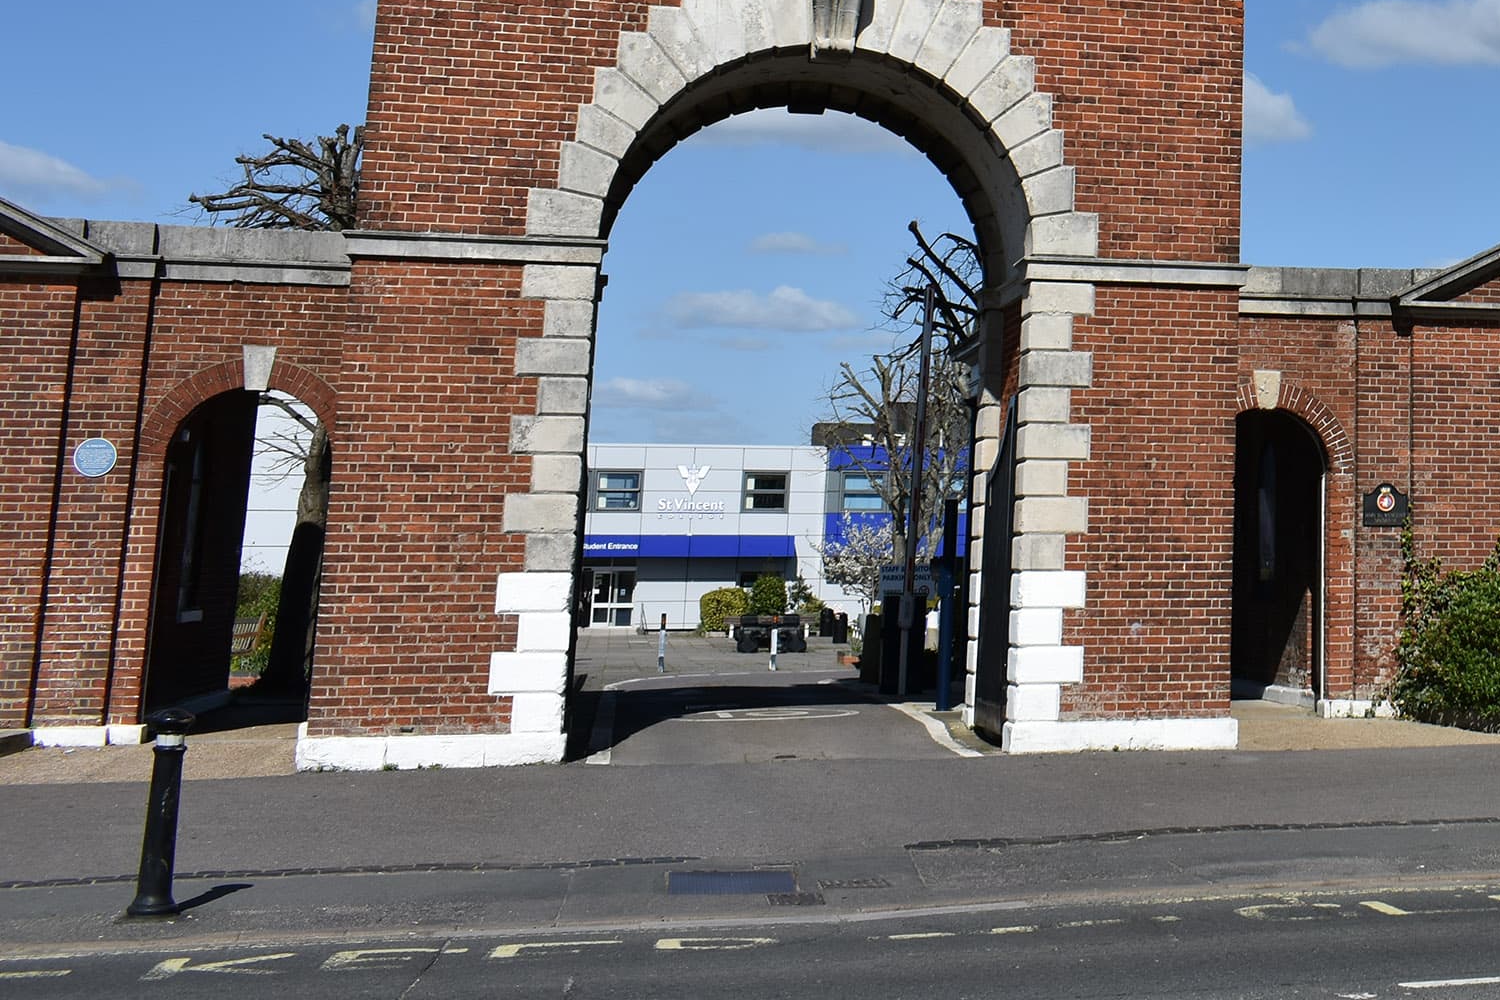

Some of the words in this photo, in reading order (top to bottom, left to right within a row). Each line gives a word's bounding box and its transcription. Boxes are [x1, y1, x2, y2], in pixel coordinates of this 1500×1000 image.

[658, 498, 673, 511] St
[674, 498, 725, 511] Vincent
[583, 542, 606, 550] tudent
[607, 542, 638, 550] Entrance
